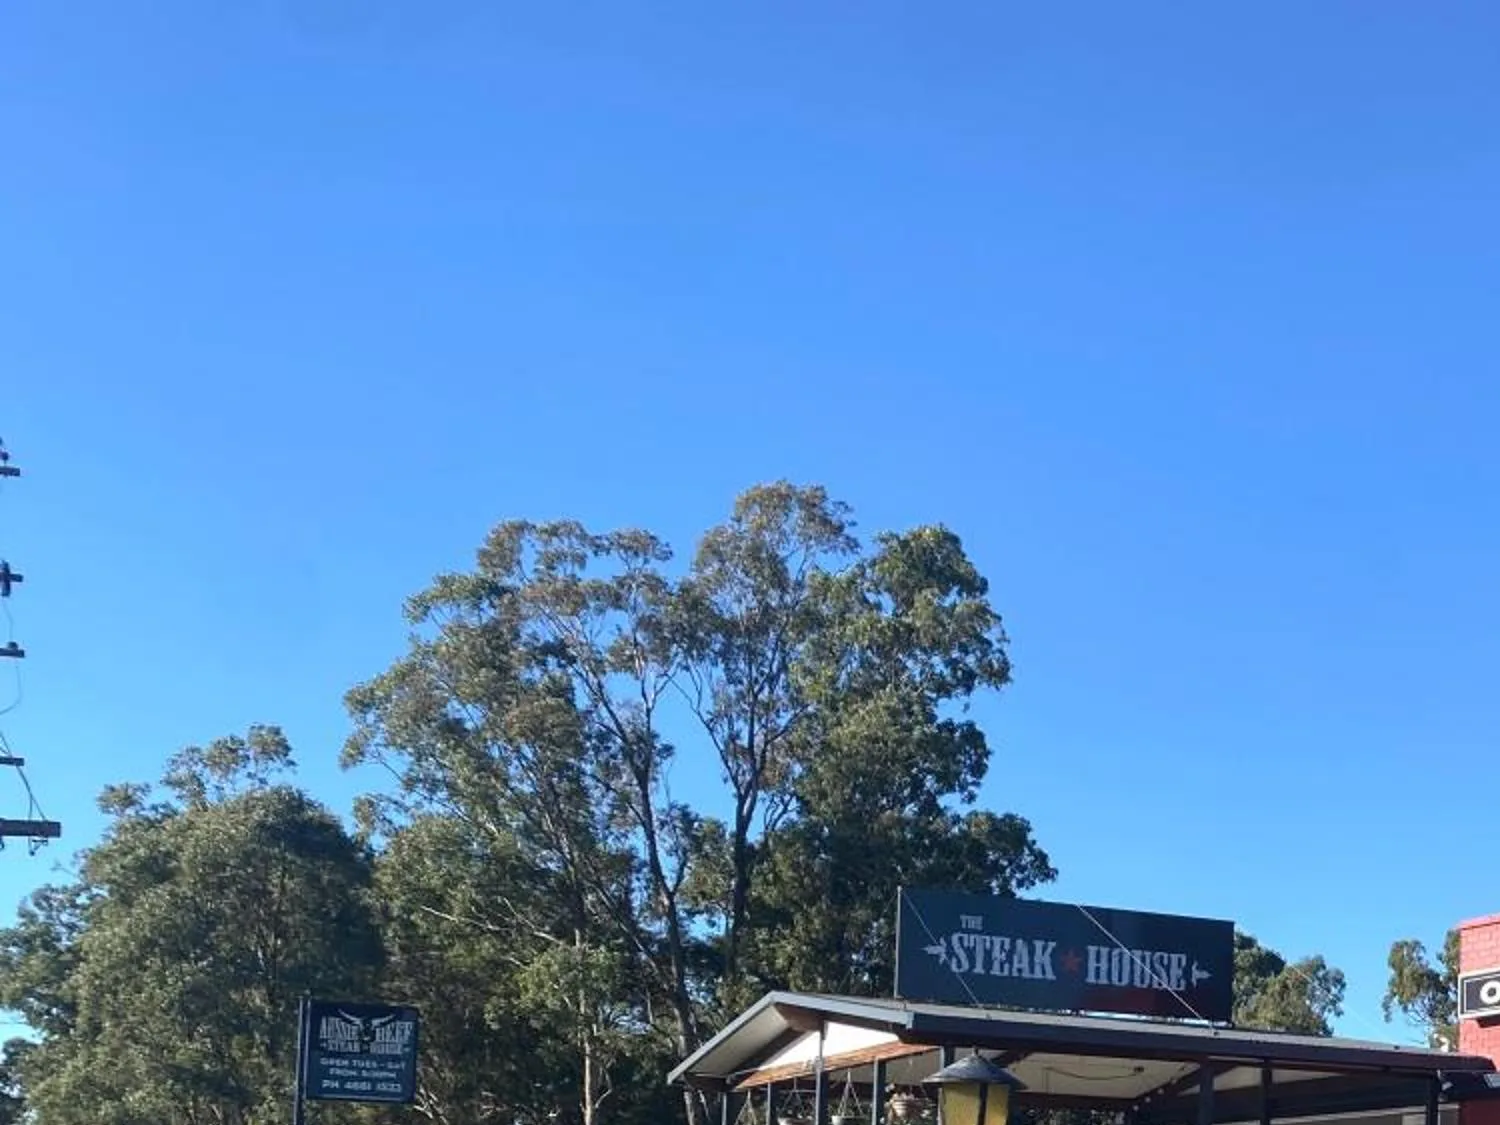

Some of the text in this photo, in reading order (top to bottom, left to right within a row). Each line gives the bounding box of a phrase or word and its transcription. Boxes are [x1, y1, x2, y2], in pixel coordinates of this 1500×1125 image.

[959, 914, 983, 931] THE
[950, 931, 1187, 991] STEAK HOUSE
[319, 1016, 413, 1044] AUSSIE BEEF
[328, 1039, 403, 1055] STEAK HOUSE
[319, 1057, 350, 1067] OPEN
[351, 1059, 378, 1069] TUES
[329, 1068, 358, 1077] FROM
[322, 1079, 339, 1089] PH
